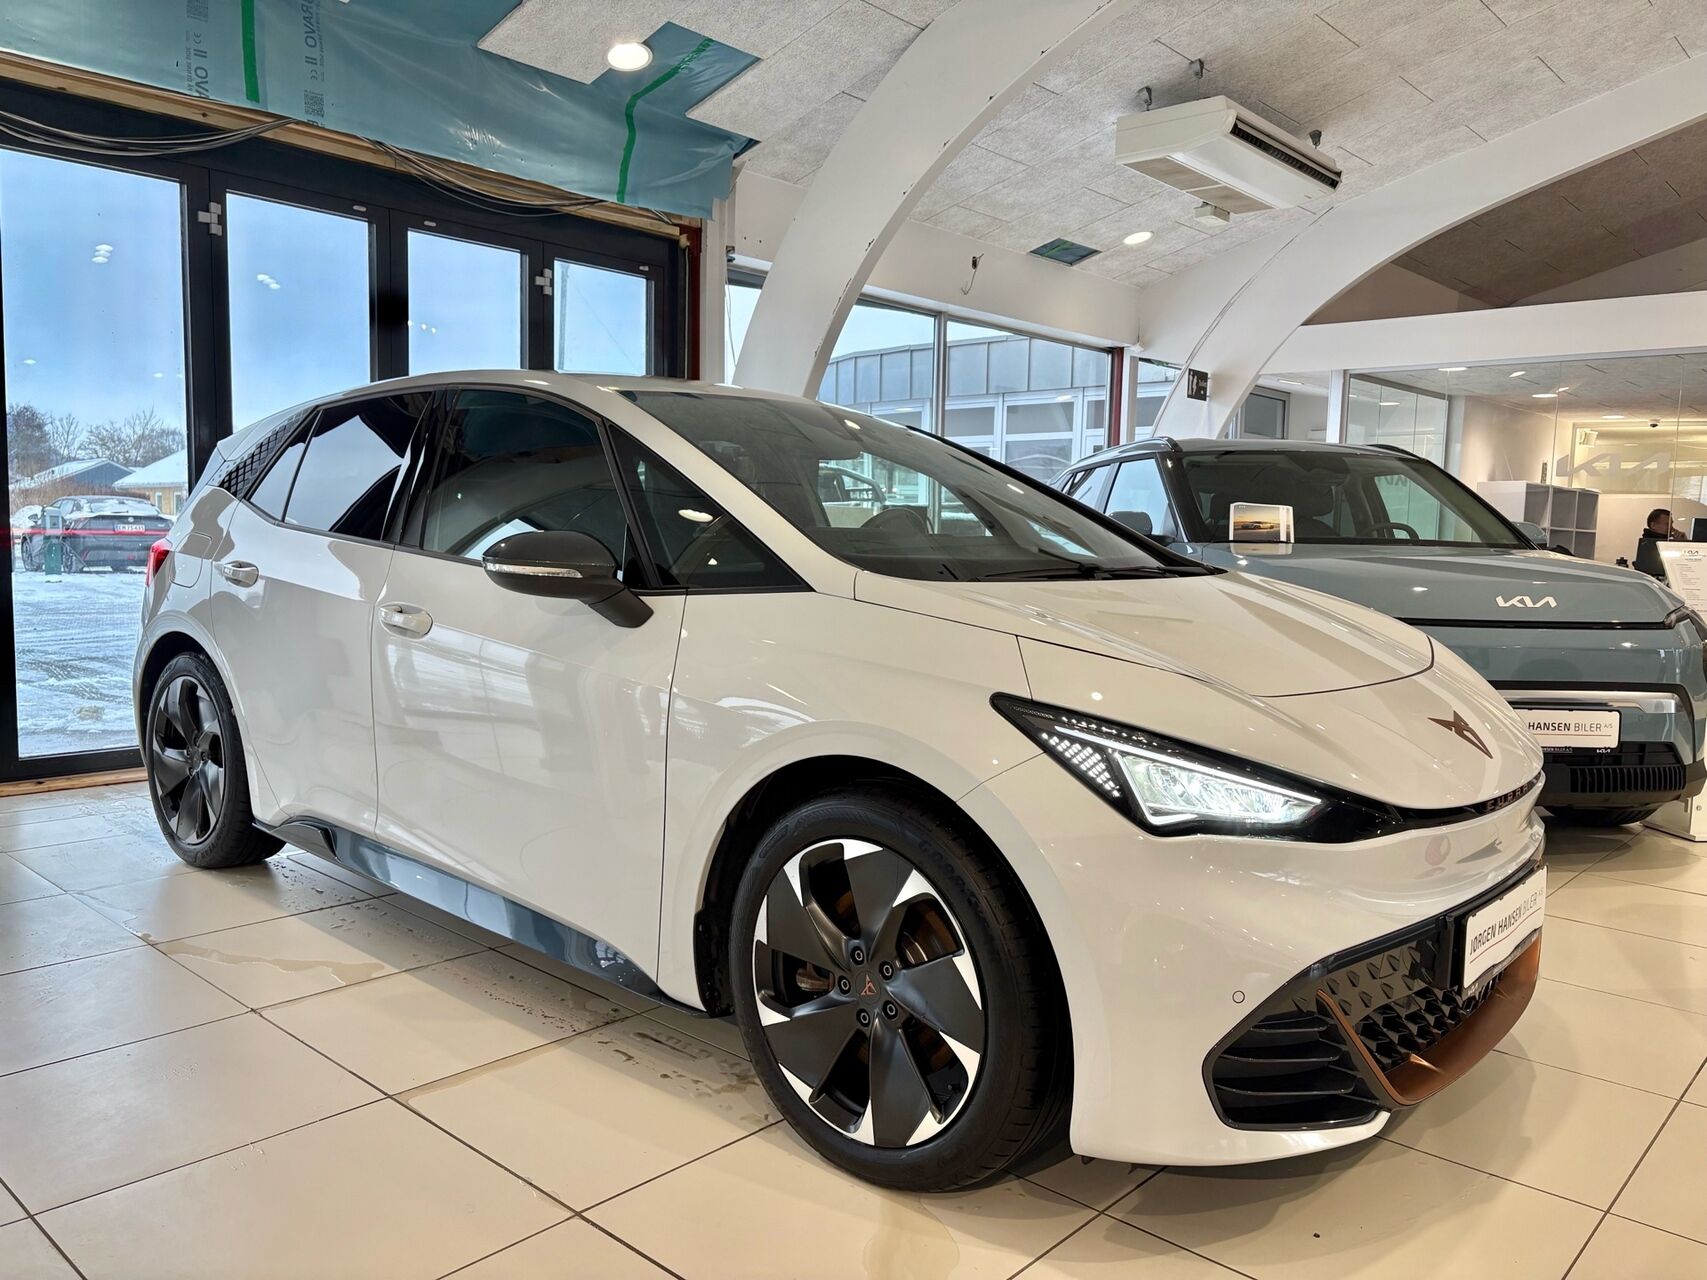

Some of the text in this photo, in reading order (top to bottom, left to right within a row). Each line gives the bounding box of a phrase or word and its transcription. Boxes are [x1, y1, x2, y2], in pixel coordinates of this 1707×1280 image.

[1556, 452, 1671, 477] KIA
[1495, 595, 1557, 608] KIA
[1528, 722, 1571, 731] HANSEN
[1574, 723, 1602, 732] BILER
[1470, 923, 1497, 956] JØRGEN
[1498, 904, 1522, 936] HANSEN
